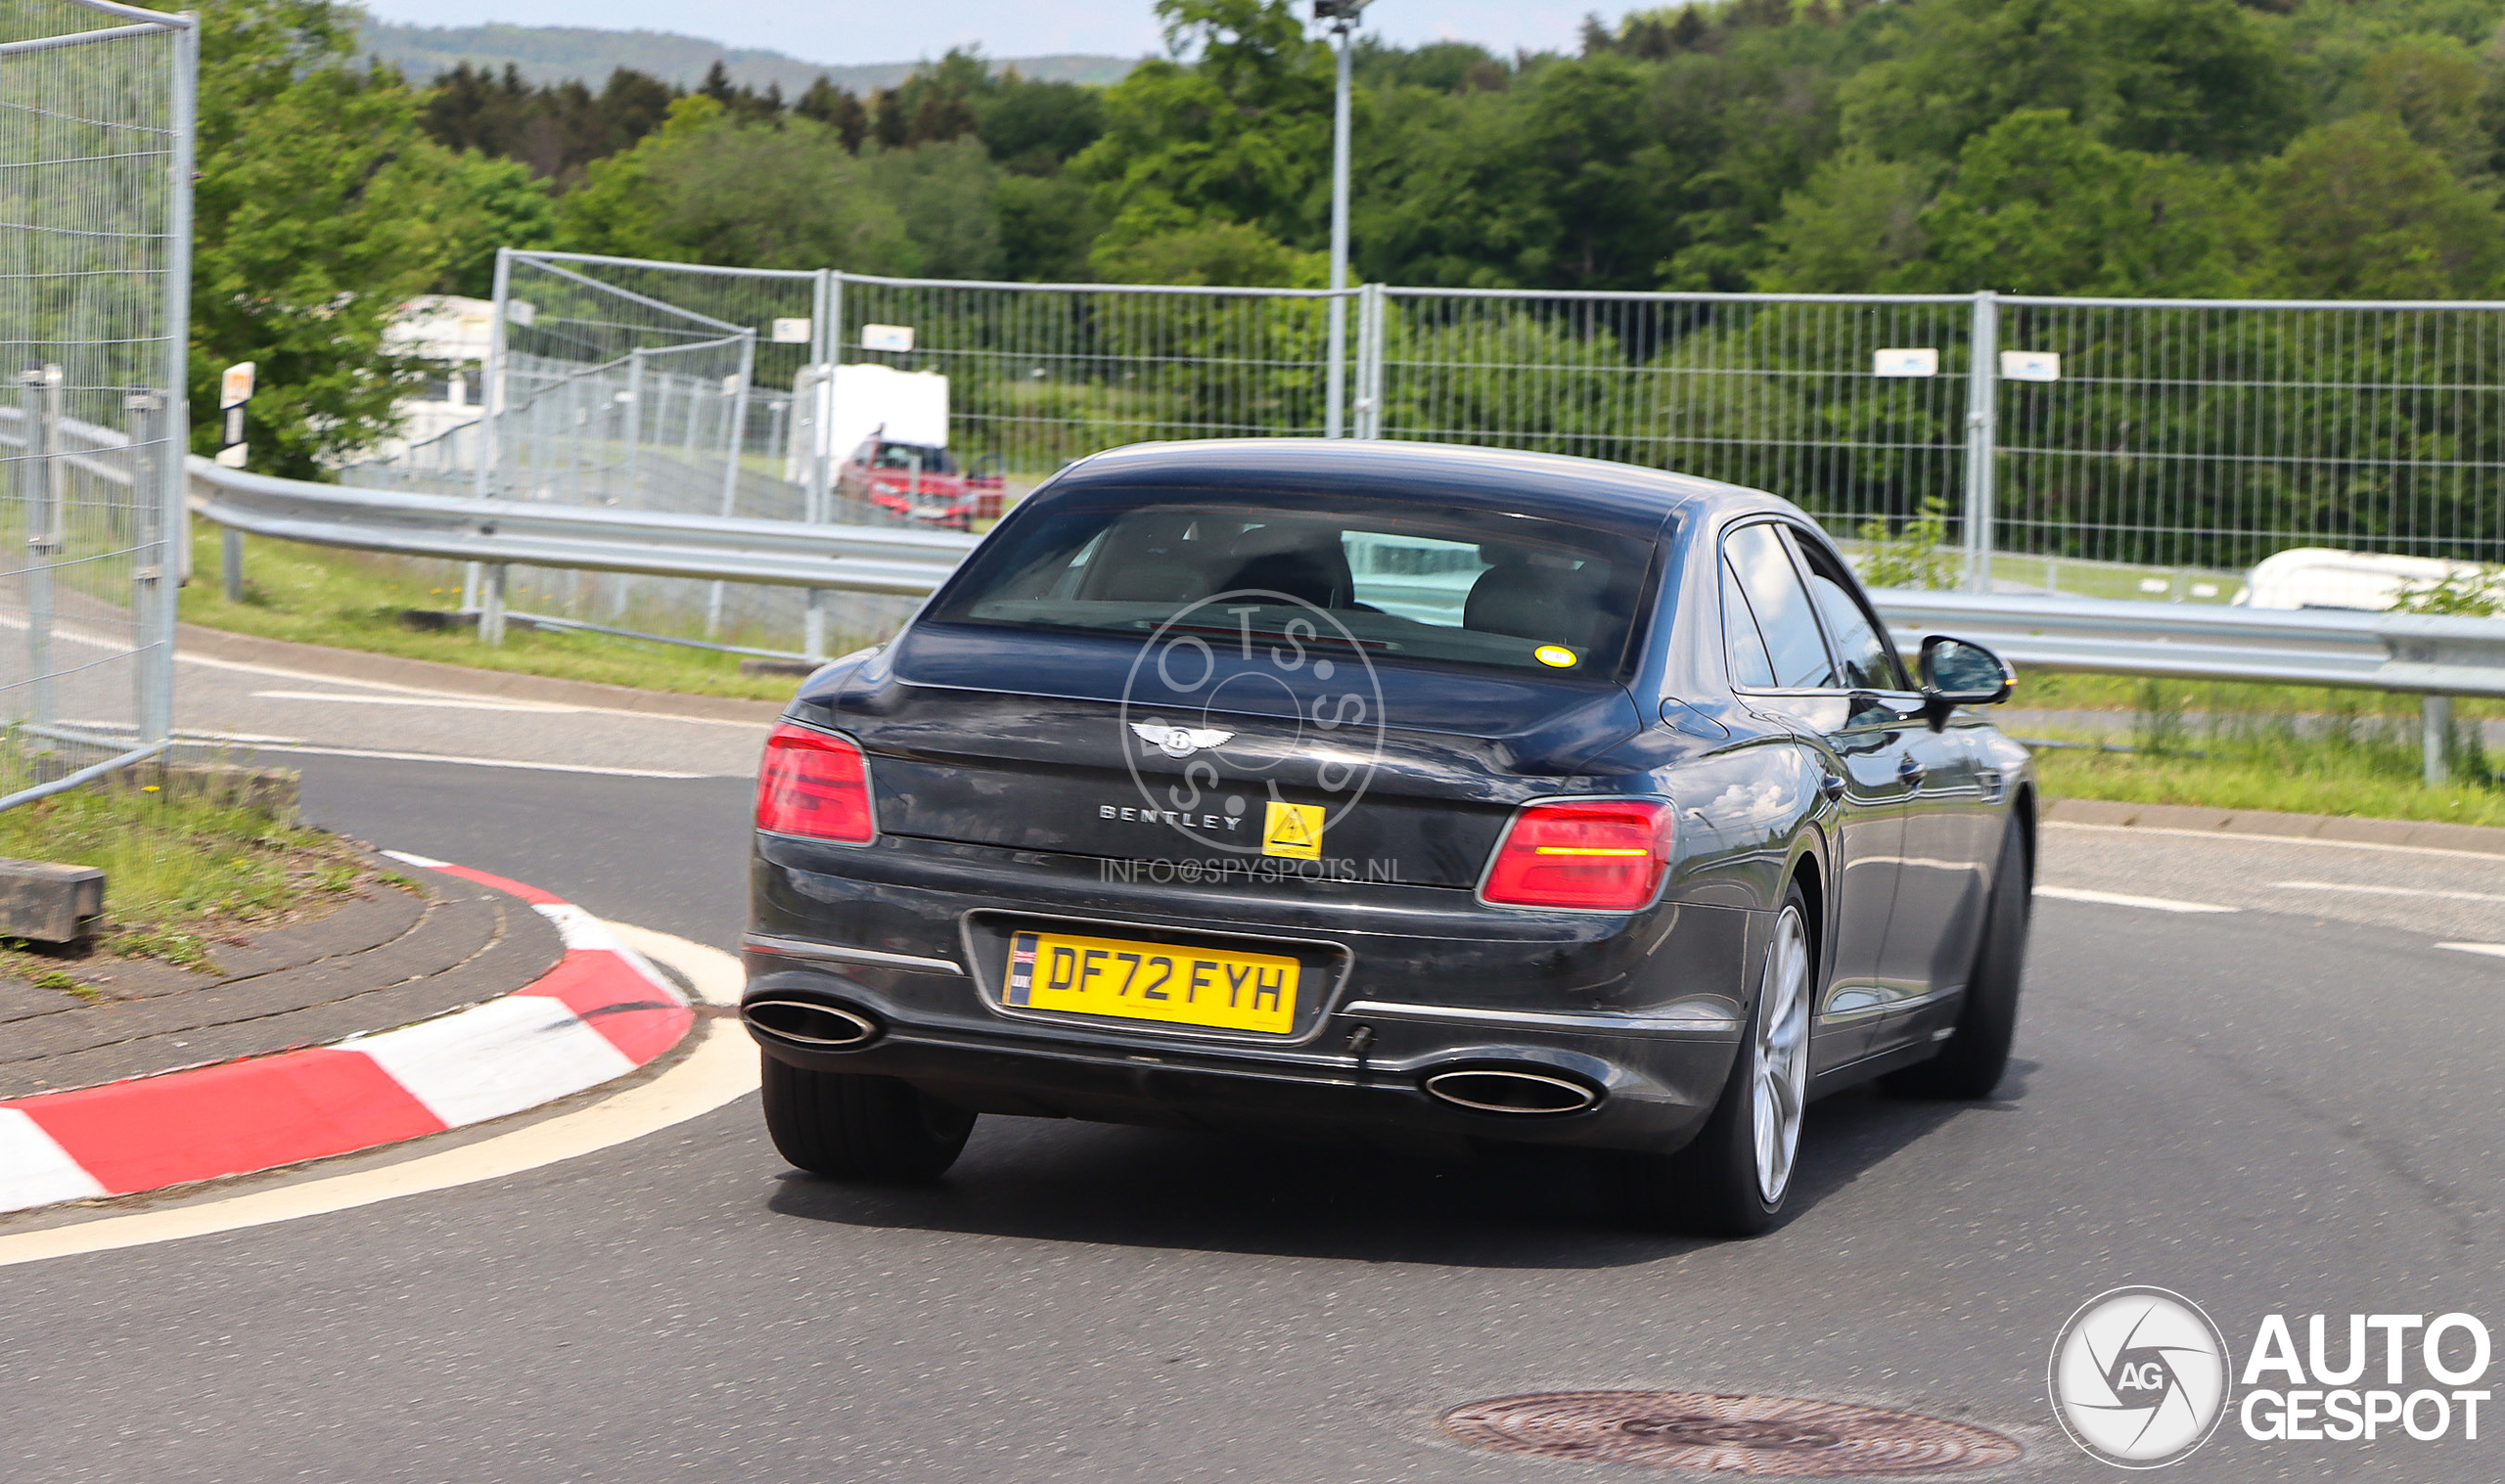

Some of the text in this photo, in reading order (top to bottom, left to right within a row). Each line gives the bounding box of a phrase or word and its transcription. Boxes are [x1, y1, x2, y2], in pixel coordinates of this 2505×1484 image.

[1099, 804, 1242, 831] BENTLEY
[1047, 946, 1285, 1012] DF72 FYH
